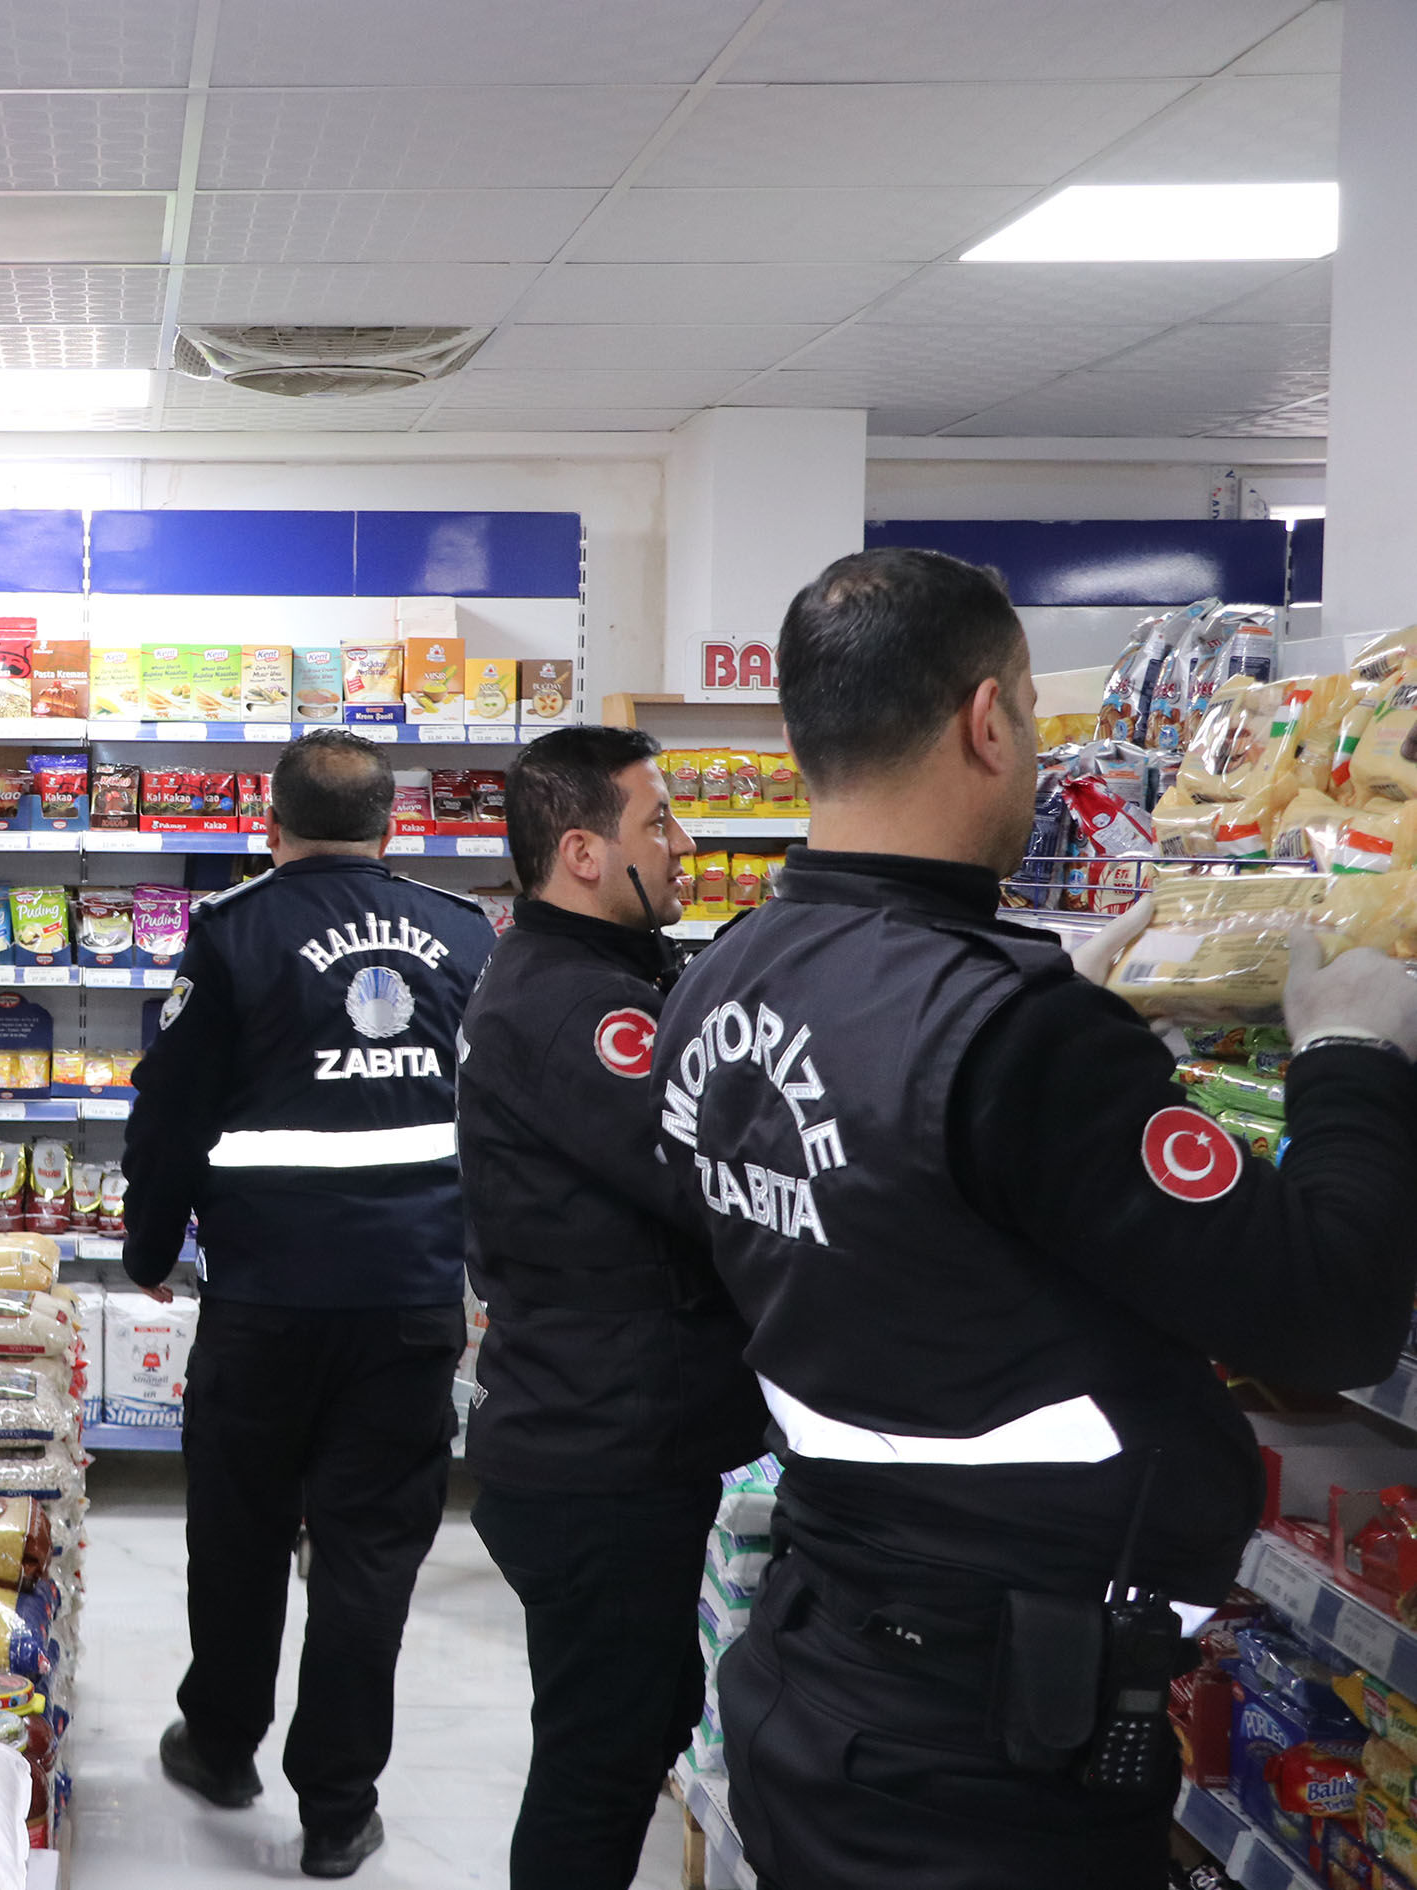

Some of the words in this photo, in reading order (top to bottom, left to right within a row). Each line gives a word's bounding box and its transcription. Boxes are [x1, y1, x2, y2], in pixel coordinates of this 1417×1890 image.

[257, 650, 278, 658] Kent
[308, 652, 329, 661] Kent
[34, 670, 55, 679] Pasta
[57, 670, 88, 679] Kreması
[45, 792, 72, 802] Kakao
[163, 792, 191, 803] Kakao
[204, 822, 227, 830] Kakao
[402, 823, 425, 832] Kakao
[17, 903, 59, 920] Puding
[140, 913, 182, 929] Puding
[299, 912, 449, 972] HALİLİYE
[314, 1047, 442, 1080] ZABITA
[694, 1152, 829, 1247] ZABITA
[1307, 1776, 1359, 1802] Balık
